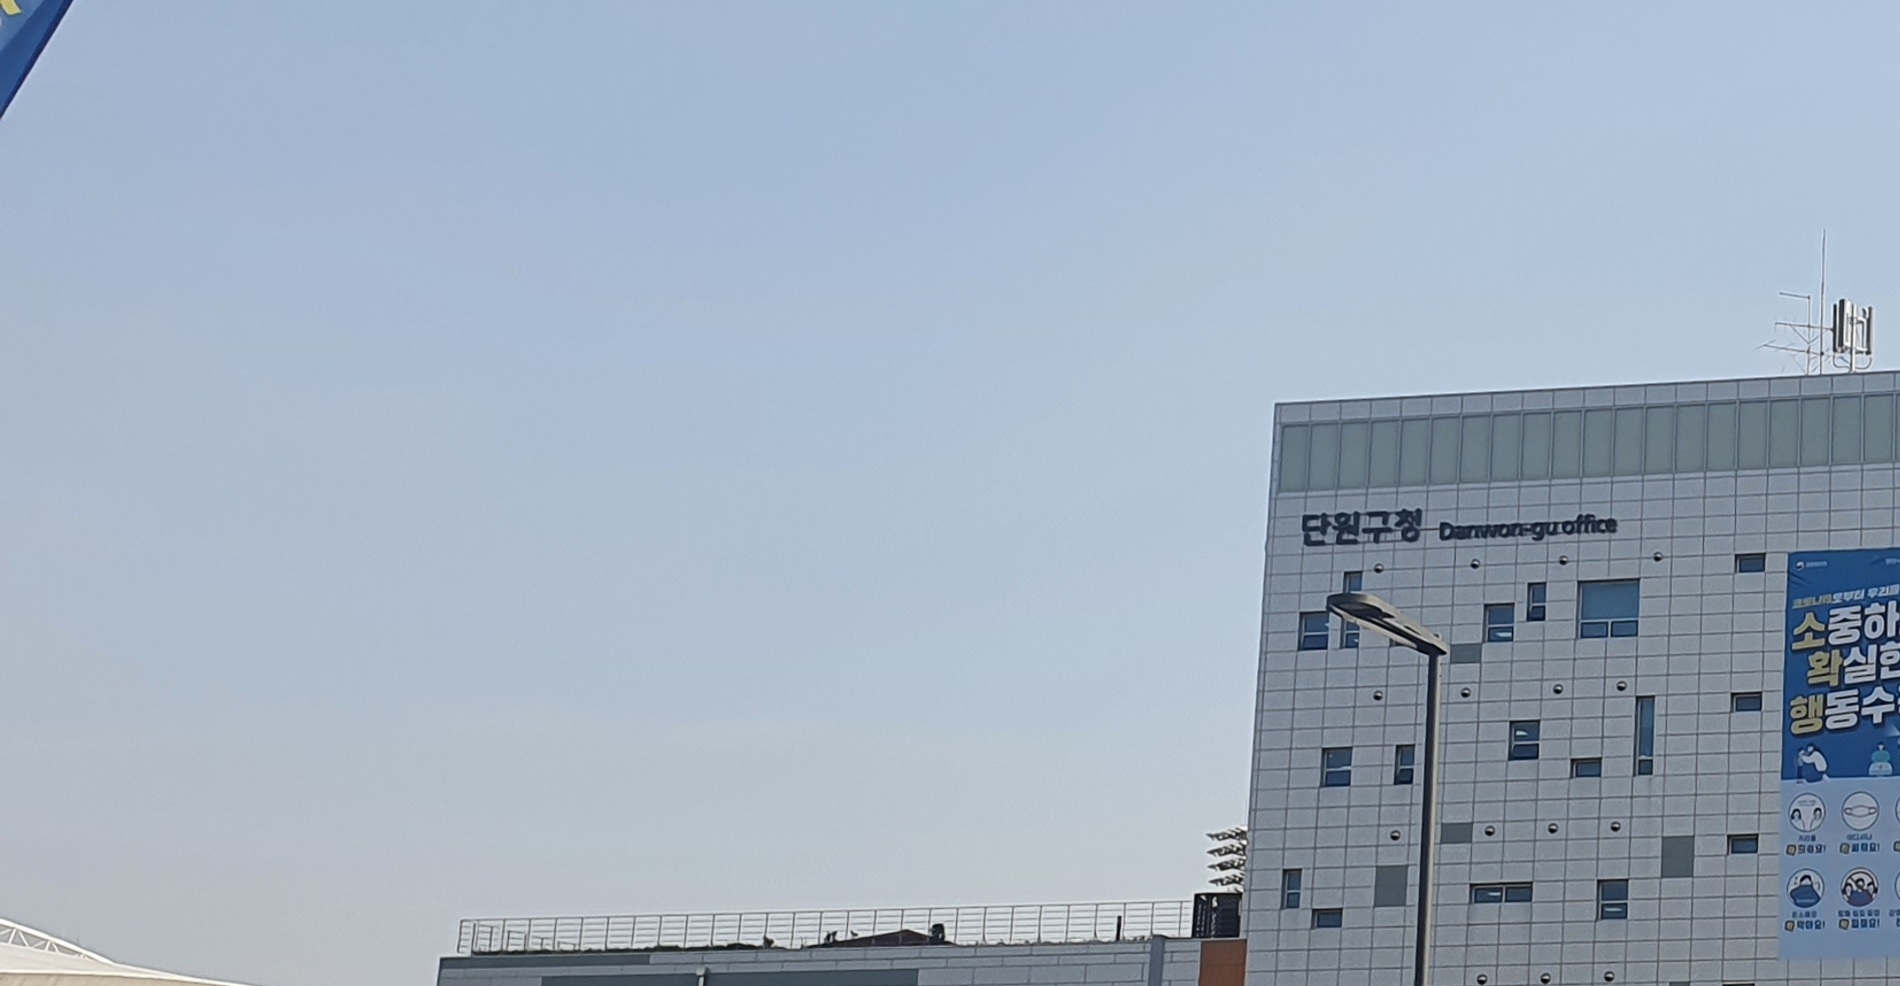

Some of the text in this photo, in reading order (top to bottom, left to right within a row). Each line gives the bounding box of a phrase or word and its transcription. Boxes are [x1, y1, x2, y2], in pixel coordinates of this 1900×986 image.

[1302, 508, 1618, 546] 단원구청 Danwon-gu office
